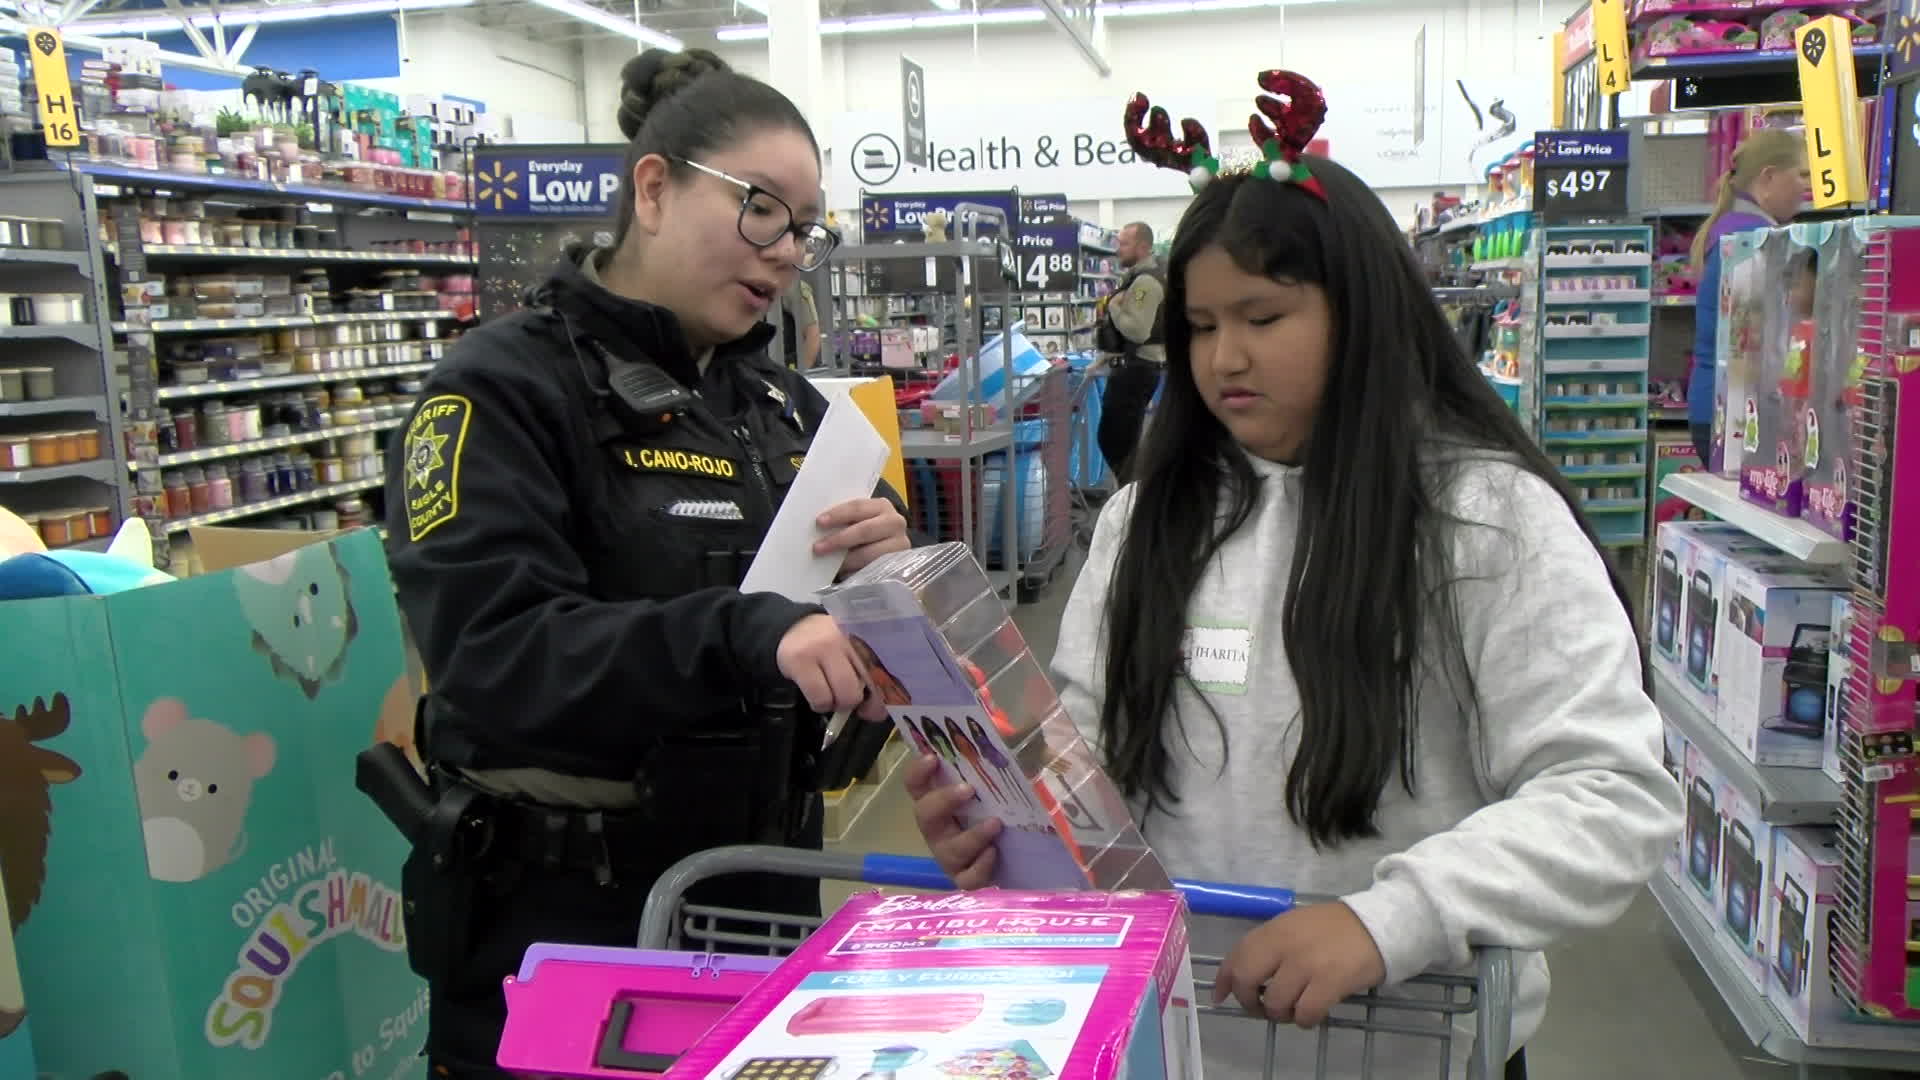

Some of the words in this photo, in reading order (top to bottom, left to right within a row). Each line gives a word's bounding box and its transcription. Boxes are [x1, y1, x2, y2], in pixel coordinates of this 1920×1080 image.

[1603, 43, 1614, 62] L
[1606, 69, 1616, 87] 4
[46, 94, 67, 114] H
[49, 123, 73, 141] 16
[1815, 127, 1831, 158] L
[1034, 135, 1060, 168] &
[1558, 145, 1582, 155] Low
[1583, 144, 1612, 155] Price
[528, 160, 583, 173] Everyday
[528, 173, 592, 202] Low
[1547, 170, 1611, 198] $497
[1821, 169, 1836, 198] 5
[935, 207, 979, 223] Prce
[1022, 235, 1054, 247] Price
[640, 449, 734, 478] CANO-ROJO
[411, 491, 452, 529] COUNTY
[231, 835, 337, 929] ORIGINAL
[866, 895, 984, 916] Barbie
[868, 918, 989, 932] MALIBU
[997, 917, 1111, 927] HOUSE
[353, 1044, 375, 1076] to
